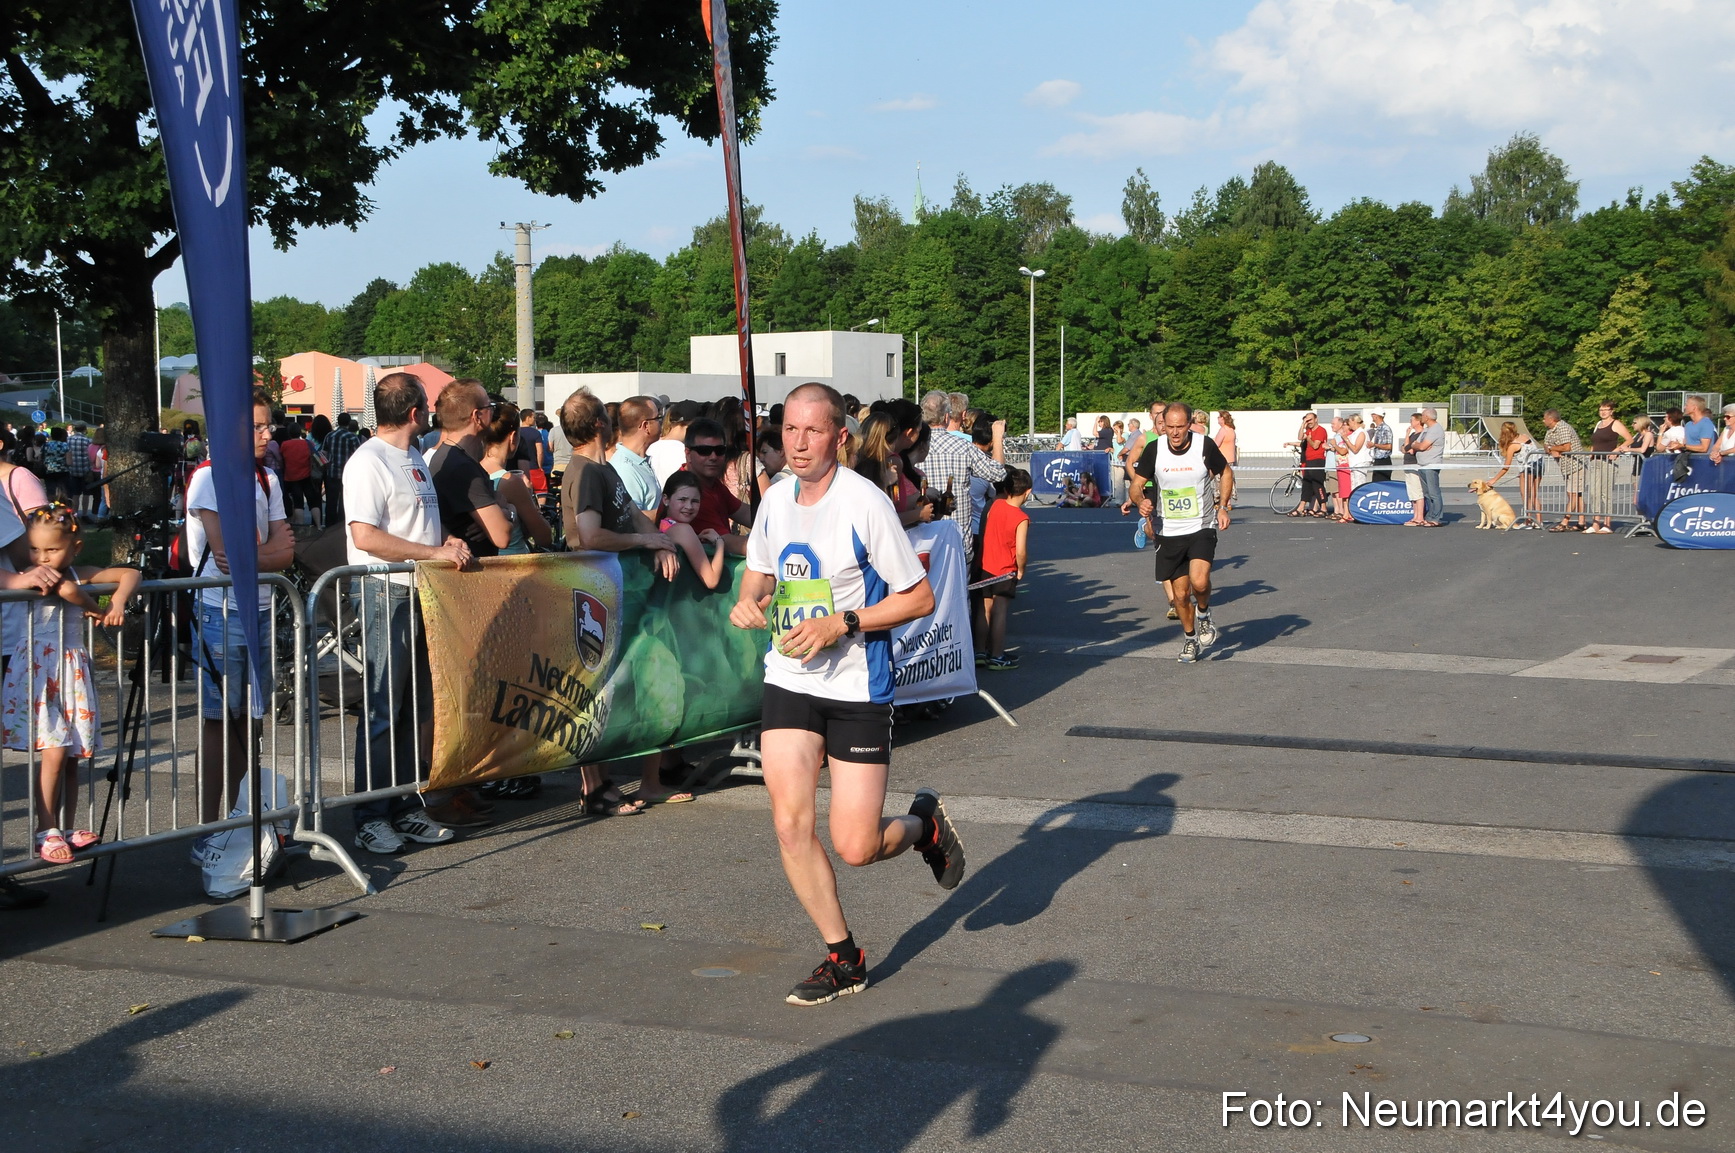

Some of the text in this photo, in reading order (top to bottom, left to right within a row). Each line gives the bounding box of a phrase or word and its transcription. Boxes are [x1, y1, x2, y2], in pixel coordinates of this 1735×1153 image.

[1052, 470, 1092, 481] Fisch
[1666, 483, 1716, 500] Fisch
[1168, 498, 1192, 511] 549
[1368, 499, 1412, 510] Fische
[785, 563, 808, 577] TÜV
[895, 644, 962, 687] ammsbräu
[490, 680, 598, 760] Lammsb
